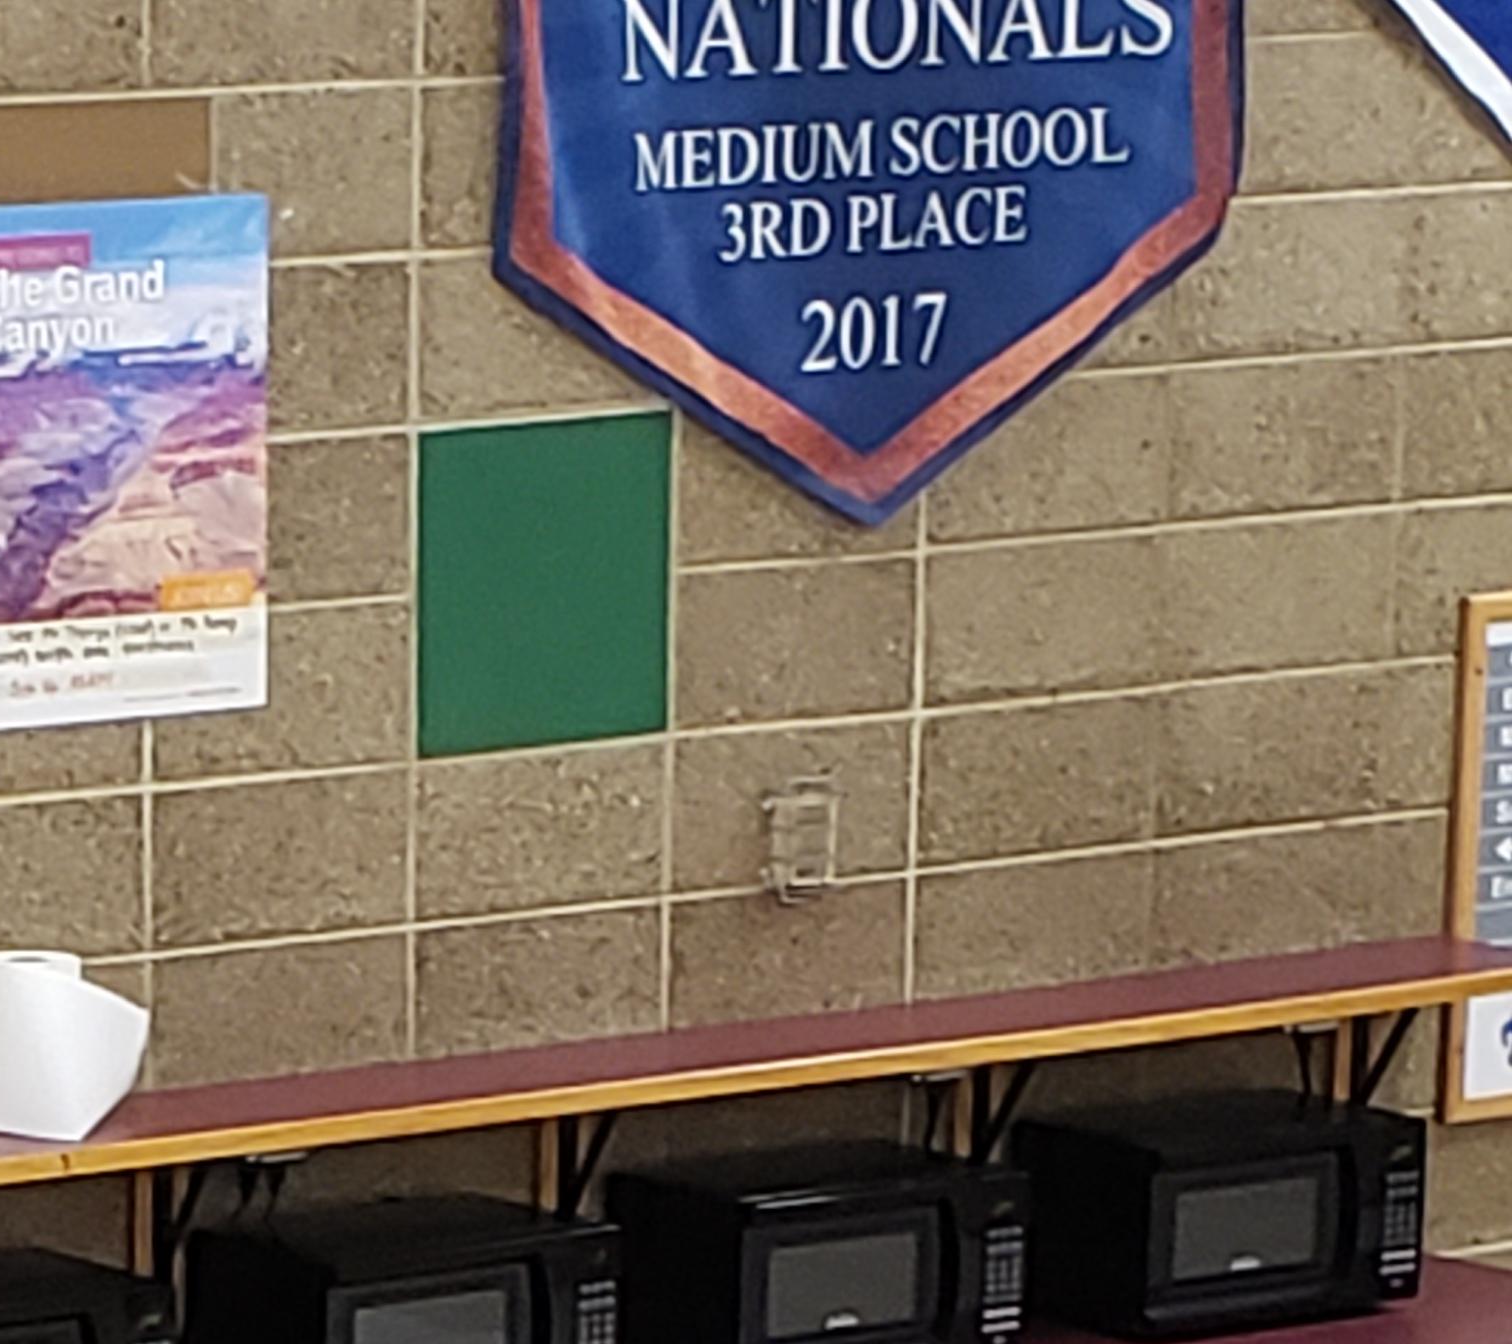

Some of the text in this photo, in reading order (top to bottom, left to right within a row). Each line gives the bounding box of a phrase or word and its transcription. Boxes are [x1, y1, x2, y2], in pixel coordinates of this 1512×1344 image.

[621, 0, 1174, 82] NATIONALS
[634, 107, 1129, 191] MEDIUM SCHOOL
[720, 185, 1027, 261] 3RD PLACE
[54, 259, 165, 304] Grand
[800, 292, 948, 372] 2017
